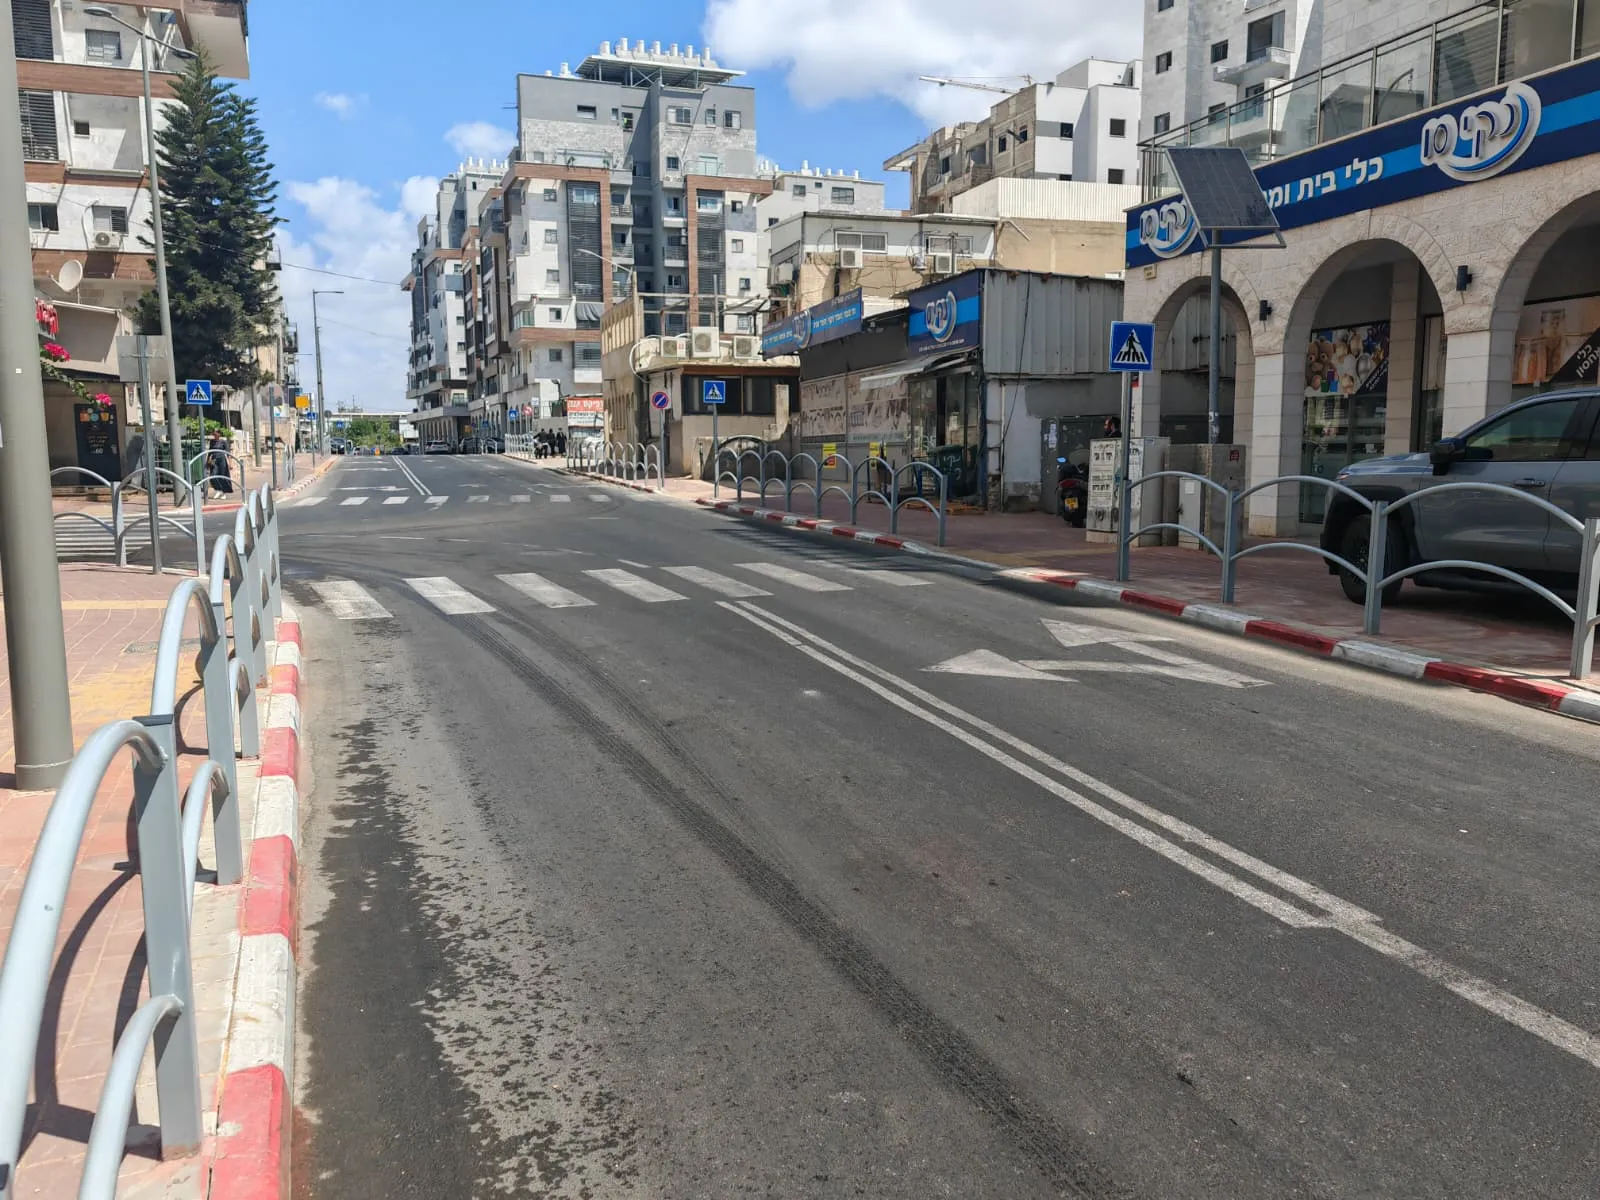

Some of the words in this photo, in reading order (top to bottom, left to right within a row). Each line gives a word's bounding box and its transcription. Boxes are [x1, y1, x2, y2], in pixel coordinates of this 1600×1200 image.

[1345, 156, 1384, 185] כלי
[1262, 183, 1290, 209] ומ
[1296, 170, 1337, 202] בית
[1576, 344, 1592, 360] כלי
